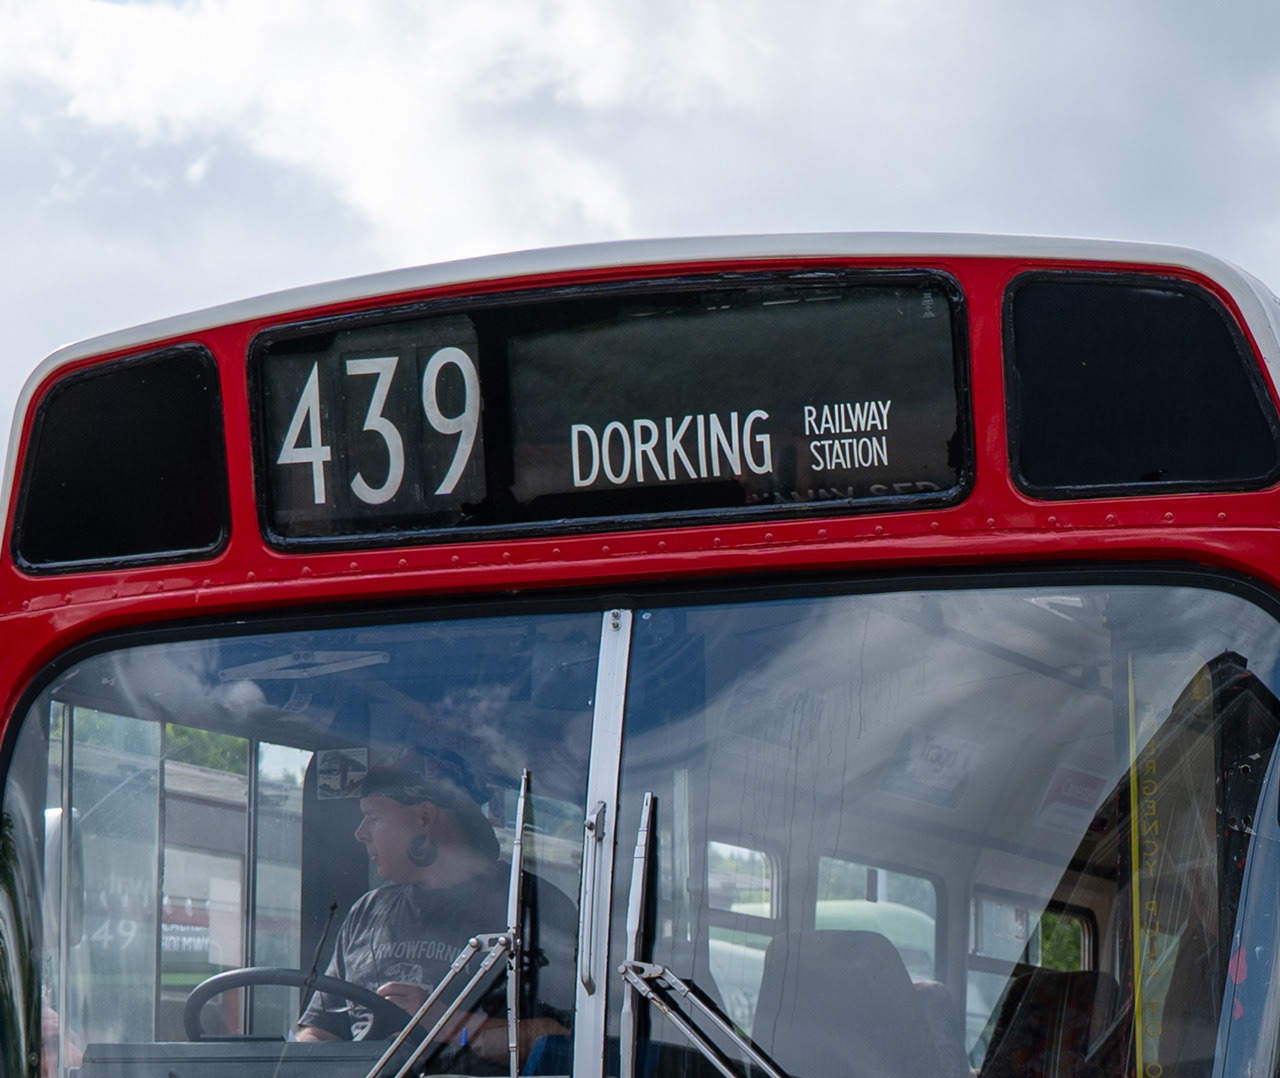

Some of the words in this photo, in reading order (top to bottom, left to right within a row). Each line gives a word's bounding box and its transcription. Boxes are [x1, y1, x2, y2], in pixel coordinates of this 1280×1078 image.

[276, 346, 481, 506] 439
[571, 409, 773, 488] DORKING
[803, 399, 892, 437] RAILWAY
[809, 435, 889, 471] STATION
